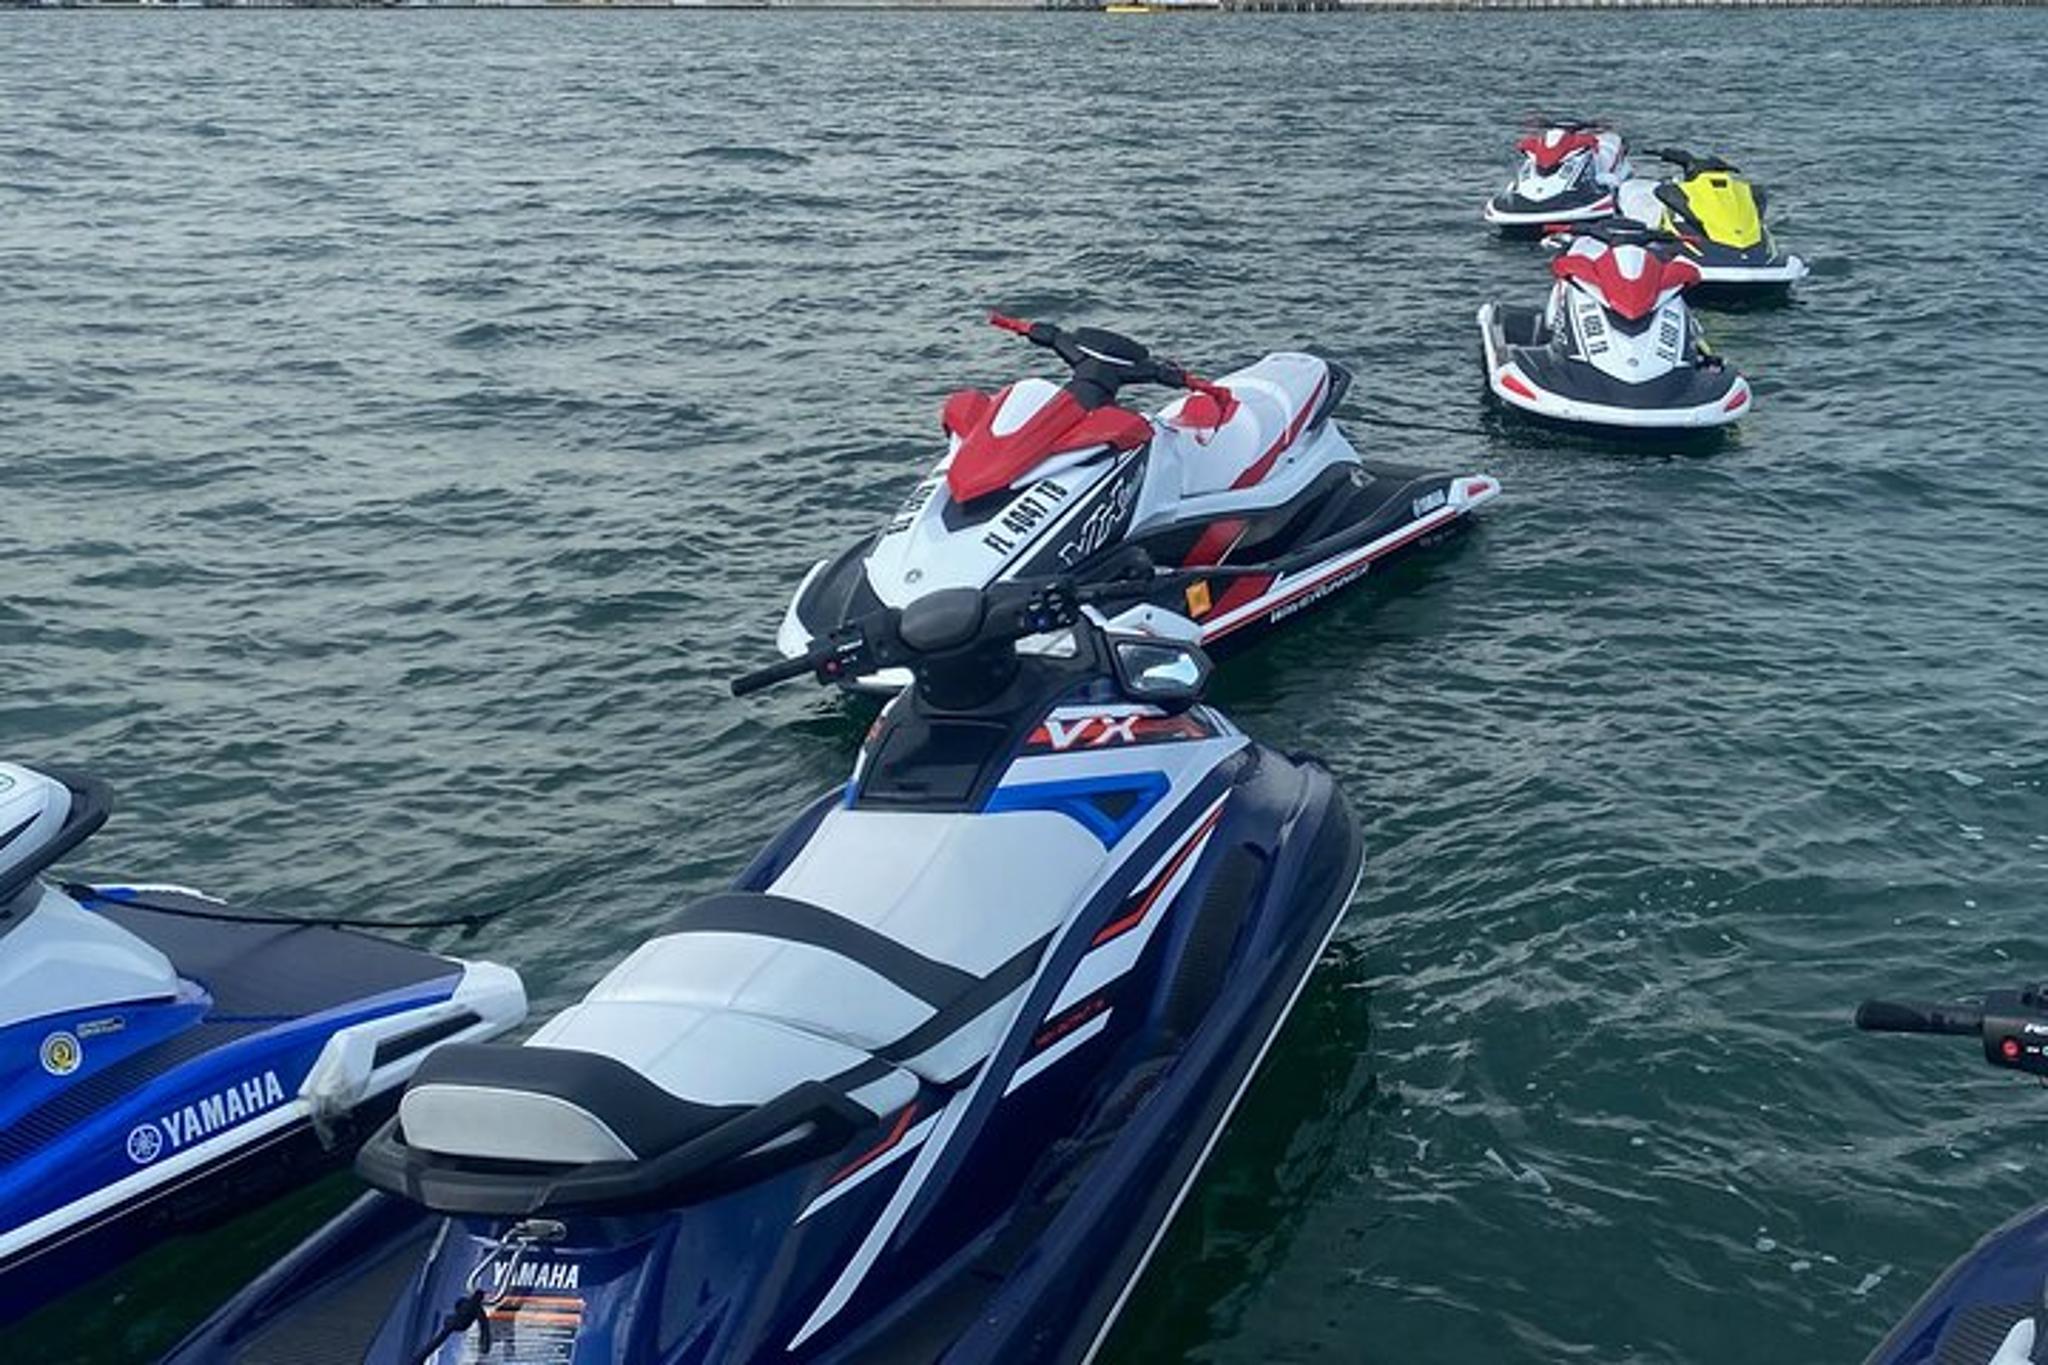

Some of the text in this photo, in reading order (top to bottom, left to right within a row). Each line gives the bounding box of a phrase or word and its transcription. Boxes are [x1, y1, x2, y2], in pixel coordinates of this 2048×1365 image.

[982, 532, 1016, 556] FL
[1043, 714, 1141, 750] VX
[161, 1070, 285, 1148] YAMAHA
[492, 1261, 580, 1289] YAMAHA
